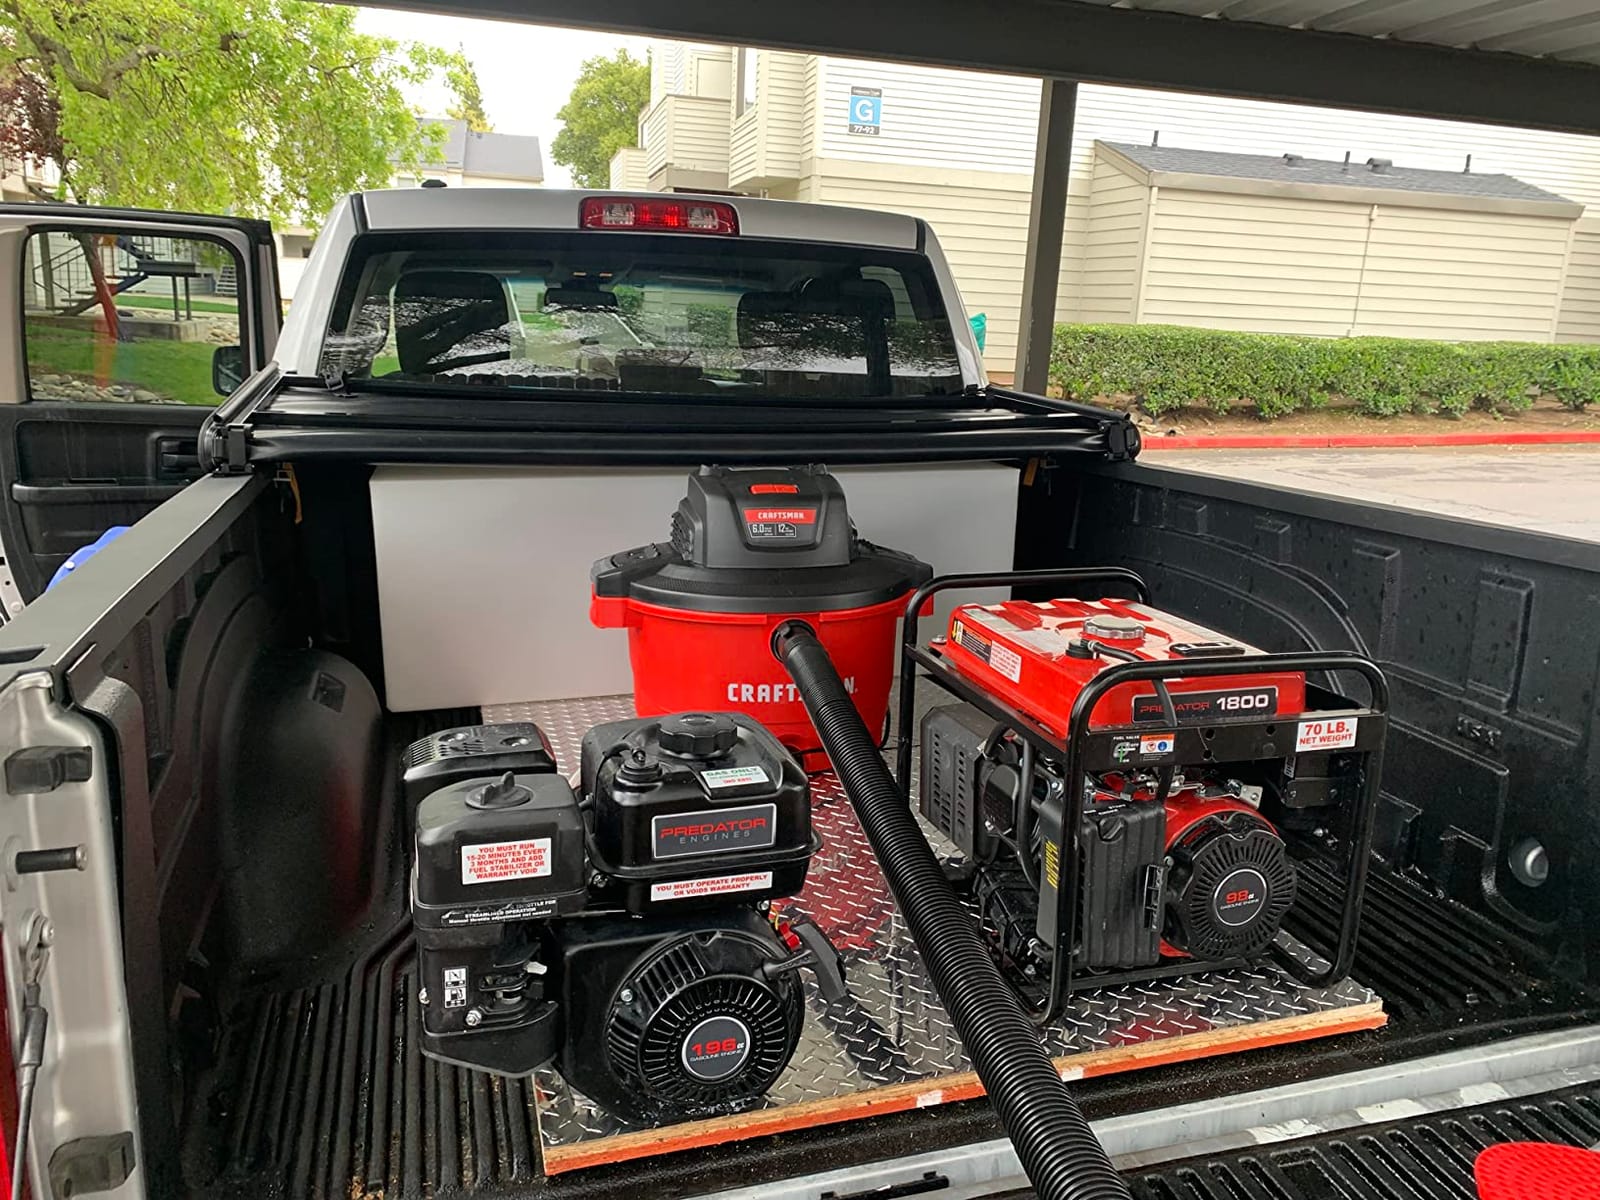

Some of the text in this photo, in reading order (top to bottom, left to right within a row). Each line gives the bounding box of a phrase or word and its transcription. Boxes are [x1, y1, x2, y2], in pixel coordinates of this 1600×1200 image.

[856, 99, 874, 122] G
[752, 524, 764, 533] 6.0
[778, 524, 786, 532] 12
[727, 676, 855, 702] CRAFTN
[1140, 694, 1269, 712] PREATOR 1800
[1305, 722, 1350, 736] 70 LB.
[1300, 734, 1352, 744] NET WEIGHT
[660, 818, 767, 839] PREDATOR
[680, 830, 750, 844] ENGINES
[488, 851, 522, 859] MINUTES
[490, 862, 532, 872] STABILIZER
[476, 870, 518, 879] WARRANTY
[696, 879, 728, 887] OPERATE
[731, 874, 768, 884] PROPERLY
[710, 883, 750, 892] WARRANTY
